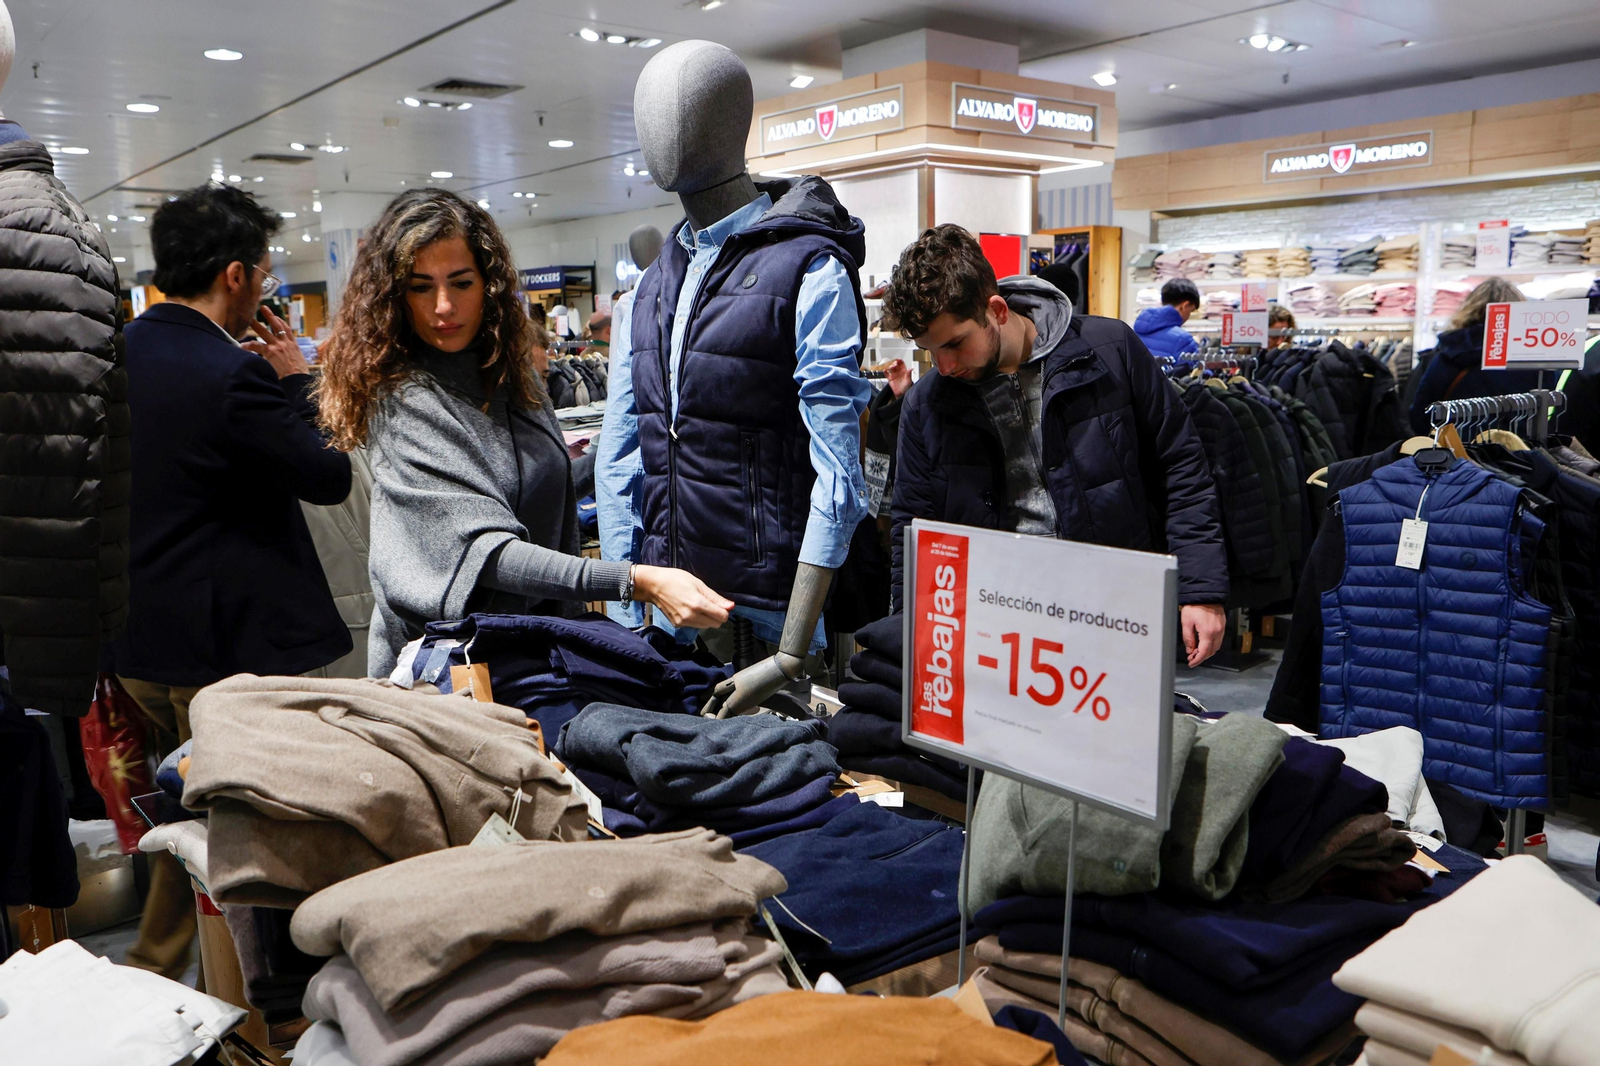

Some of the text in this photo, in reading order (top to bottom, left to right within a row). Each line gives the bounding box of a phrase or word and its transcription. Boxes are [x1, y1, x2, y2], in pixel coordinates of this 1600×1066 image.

[767, 99, 900, 142] ALVARO MORENO
[957, 98, 1094, 132] ALVARO MORENO
[1270, 141, 1428, 173] ALVARO MORENO
[530, 272, 561, 284] DOCKERS
[1234, 326, 1264, 337] -50%
[1523, 310, 1570, 325] TODO
[1490, 313, 1506, 360] rebajas
[1513, 327, 1577, 348] -50%
[978, 588, 1149, 637] Selección de productos
[926, 564, 959, 718] rebajas
[977, 632, 1111, 721] -15%
[920, 681, 933, 713] Las
